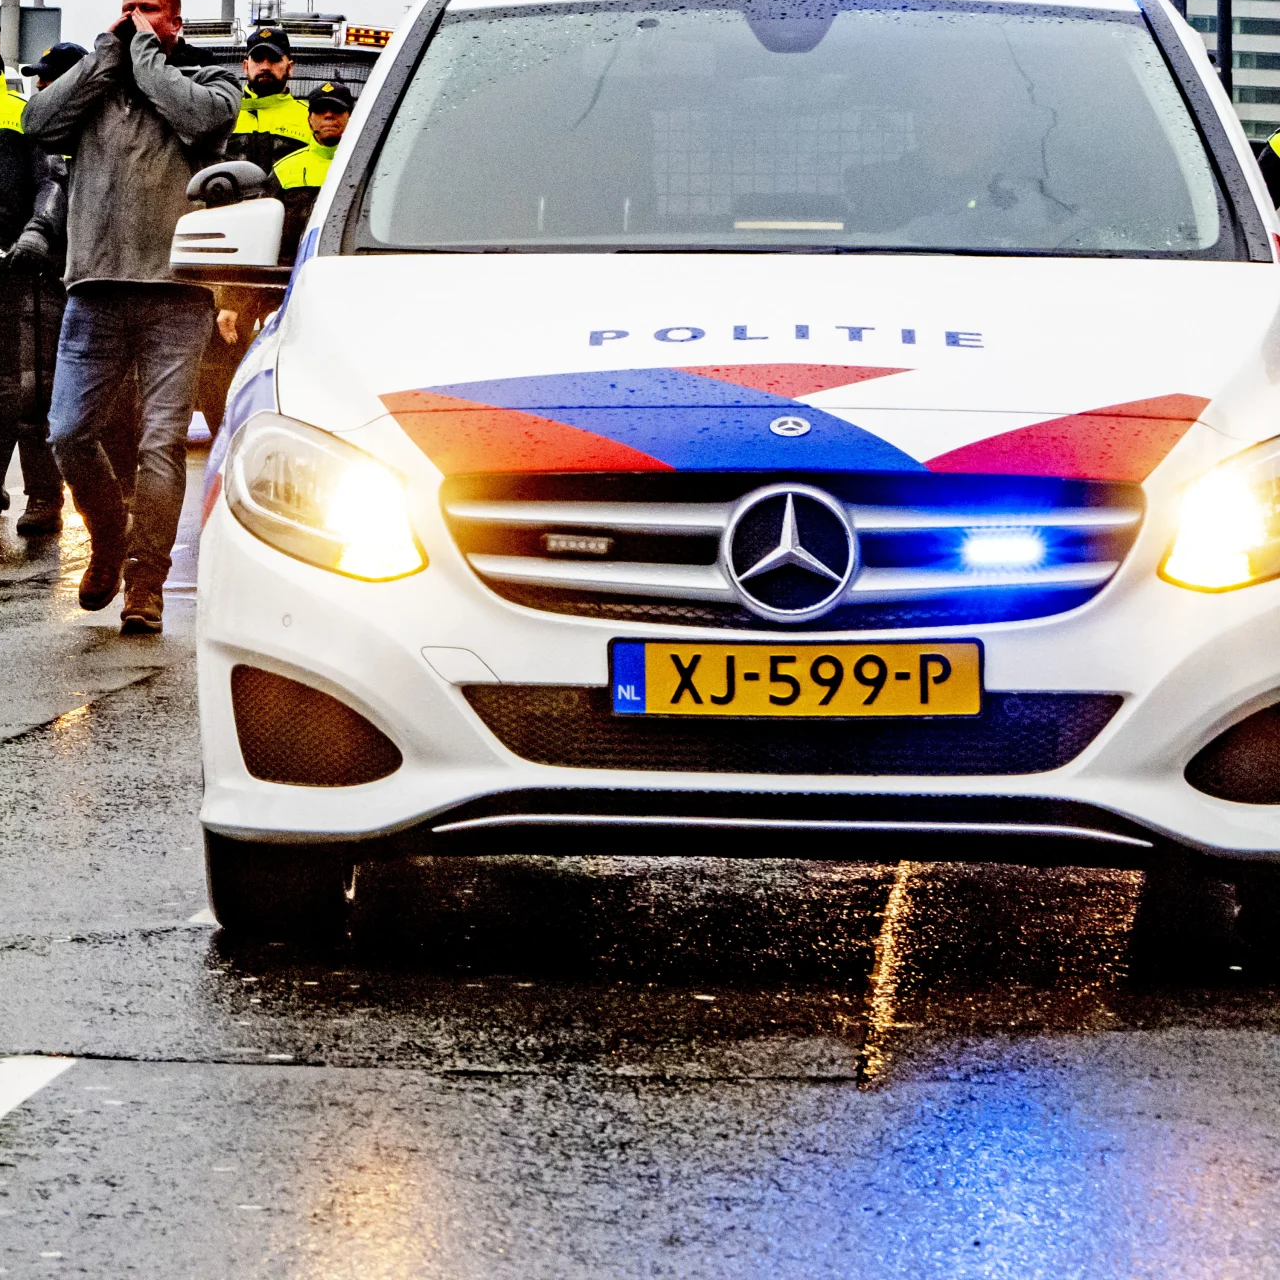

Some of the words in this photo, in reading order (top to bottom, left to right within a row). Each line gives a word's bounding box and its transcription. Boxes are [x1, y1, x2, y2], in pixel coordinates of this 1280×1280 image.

[588, 324, 985, 348] POLITIE
[617, 684, 642, 701] NL
[669, 653, 952, 706] XJ-599-P
